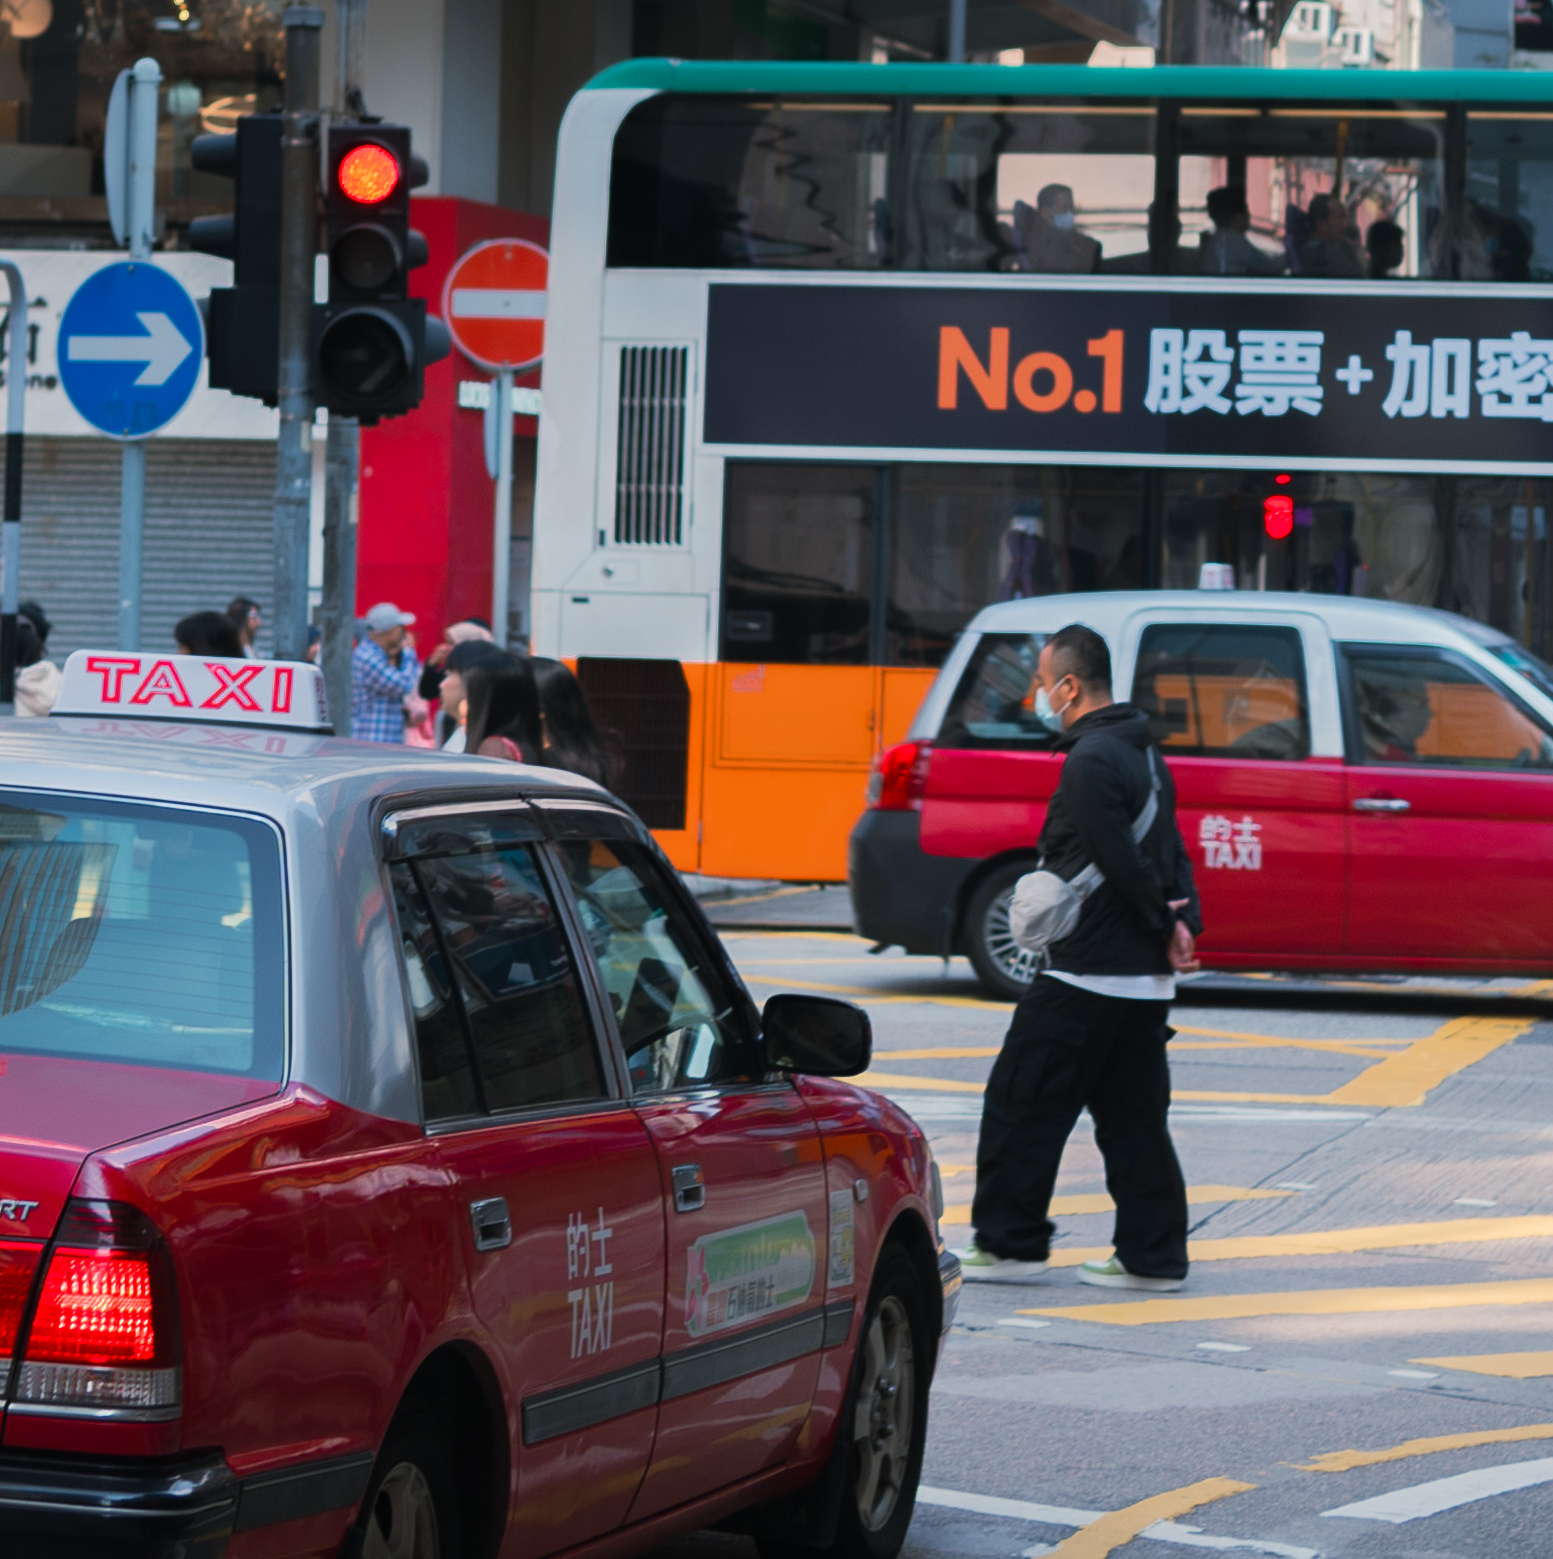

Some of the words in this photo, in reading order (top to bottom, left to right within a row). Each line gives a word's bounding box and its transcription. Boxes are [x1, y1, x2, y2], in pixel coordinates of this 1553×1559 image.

[936, 325, 1125, 415] No.1
[86, 656, 295, 714] TAXI
[1200, 814, 1261, 843] 的士
[1201, 841, 1262, 871] TAXI
[566, 1206, 613, 1282] 的士
[567, 1281, 614, 1360] TAXI
